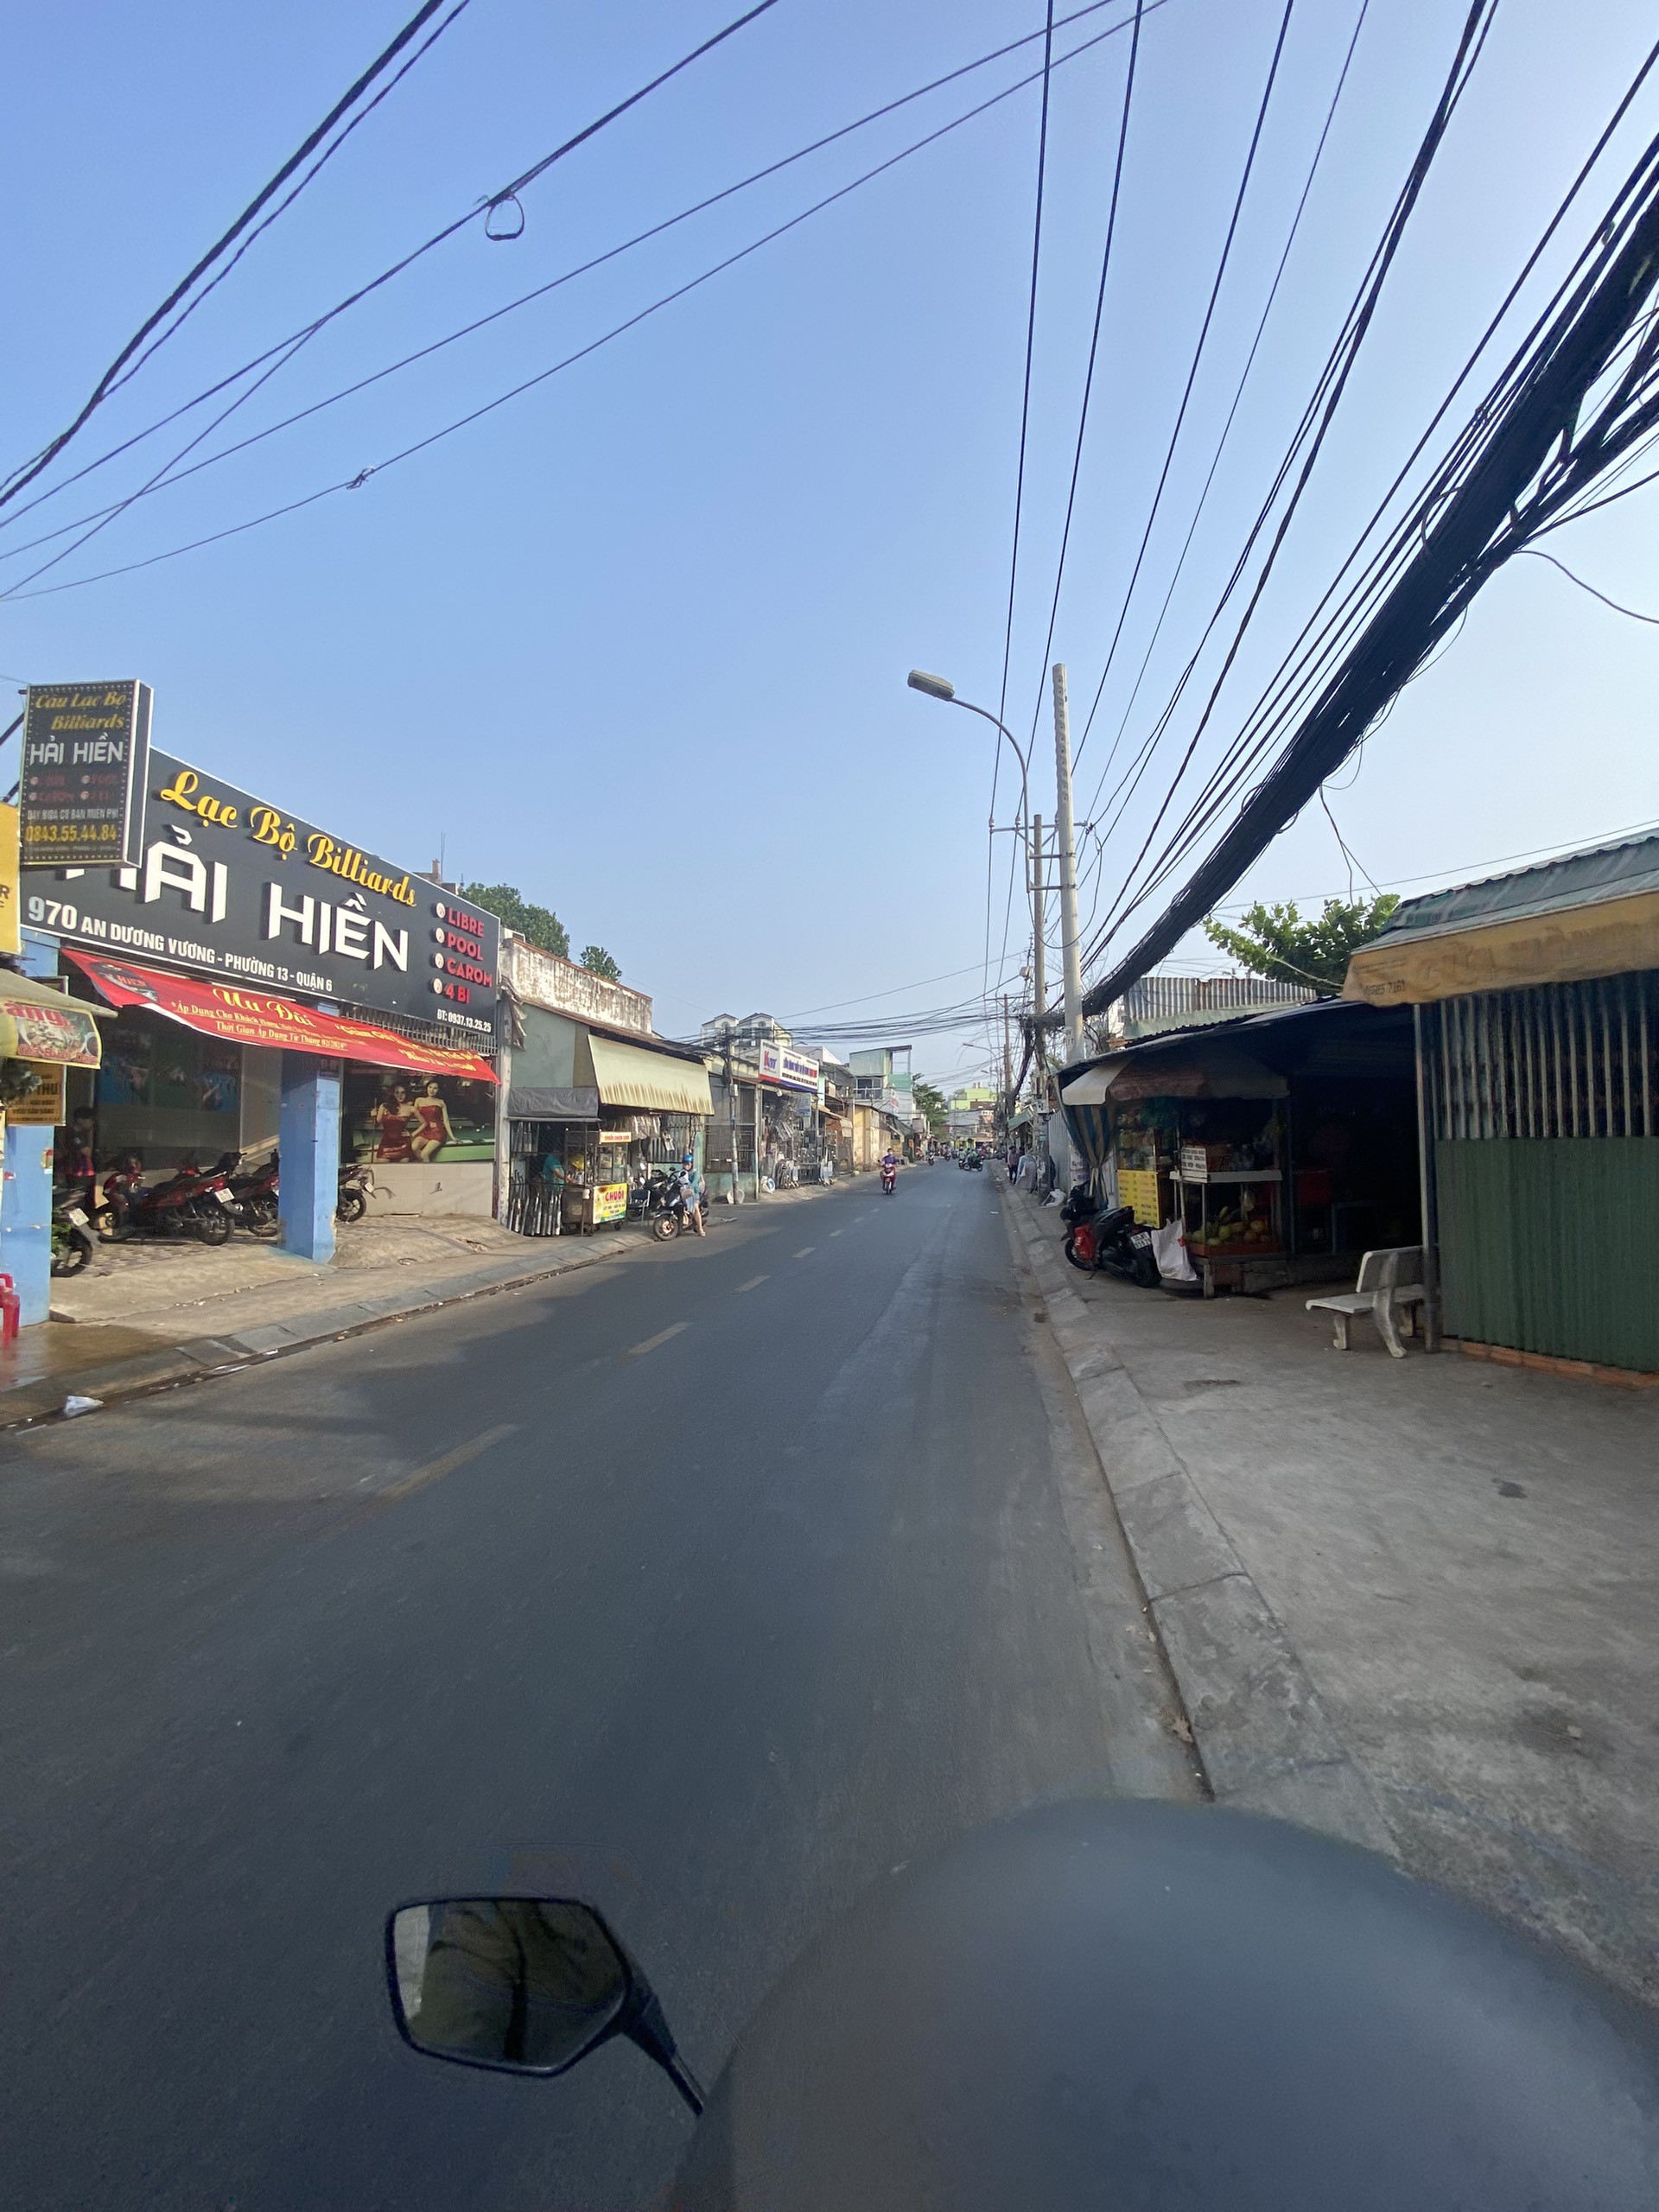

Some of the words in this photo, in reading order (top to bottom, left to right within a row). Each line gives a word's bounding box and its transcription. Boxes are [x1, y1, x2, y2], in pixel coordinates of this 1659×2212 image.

[51, 714, 125, 731] Billiards
[29, 734, 65, 766] HẢI
[73, 732, 124, 765] HIỀN
[160, 771, 238, 829] Lạc
[251, 806, 298, 861] Bộ
[308, 834, 417, 907] Billiards
[268, 892, 409, 972] HIỀN
[447, 907, 485, 938] LIBRE
[29, 896, 78, 930] 970
[80, 916, 107, 938] AN
[110, 923, 165, 952] DƯƠNG
[168, 938, 216, 964] VƯƠNG
[225, 952, 275, 979] PHƯỜNG
[276, 966, 289, 982] 13
[296, 972, 325, 991] QUẬN
[325, 980, 333, 992] 6
[447, 932, 484, 961] POOL
[446, 957, 493, 988] CAROM
[445, 983, 455, 1000] 4
[457, 985, 471, 1004] BI
[236, 1023, 256, 1035] Gian
[448, 1014, 492, 1033] 0937.13.25.25
